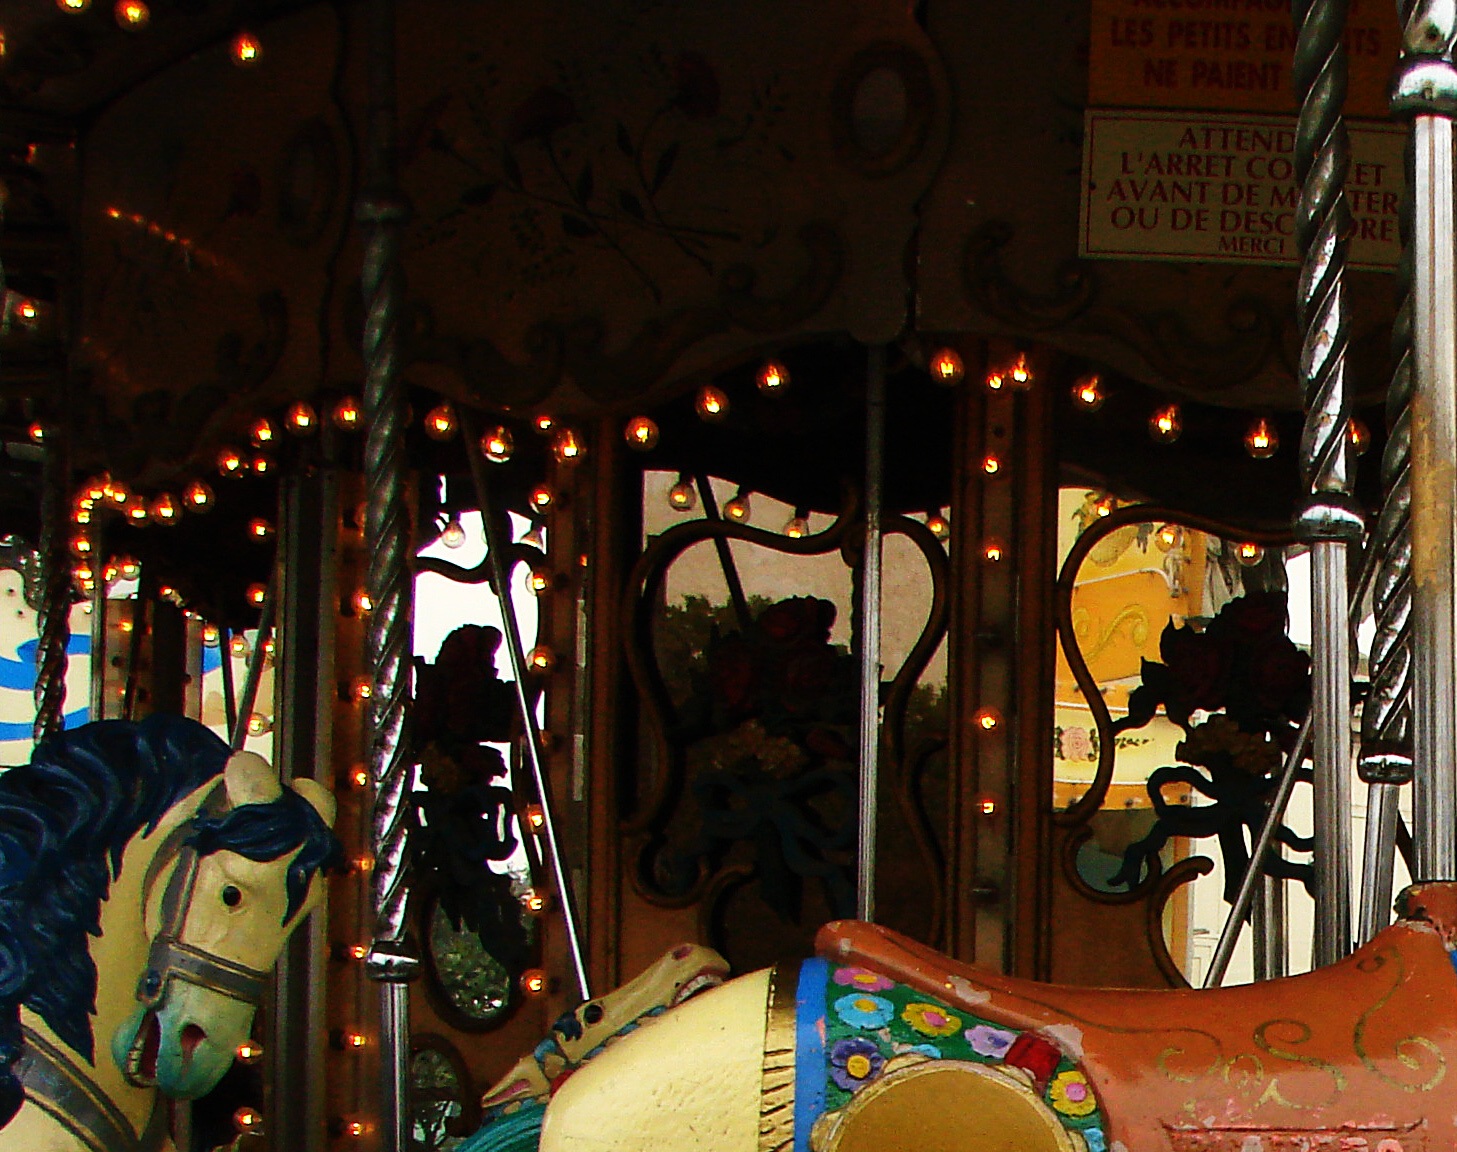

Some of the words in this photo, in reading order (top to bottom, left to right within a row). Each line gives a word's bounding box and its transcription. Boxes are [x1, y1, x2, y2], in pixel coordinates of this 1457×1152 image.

[1111, 18, 1153, 47] LES
[1168, 20, 1251, 50] PETITS
[1265, 25, 1380, 57] ENTS
[1143, 58, 1178, 88] NE
[1191, 60, 1284, 91] PAIENT
[1179, 127, 1297, 154] ATTEND
[1121, 151, 1236, 178] L'ARRET
[1246, 157, 1386, 188] COET
[1106, 179, 1214, 205] AVANT
[1222, 184, 1262, 207] DE
[1270, 186, 1398, 216] MTER
[1110, 206, 1160, 230] OU
[1171, 208, 1209, 232] DE
[1217, 235, 1285, 255] MERCI
